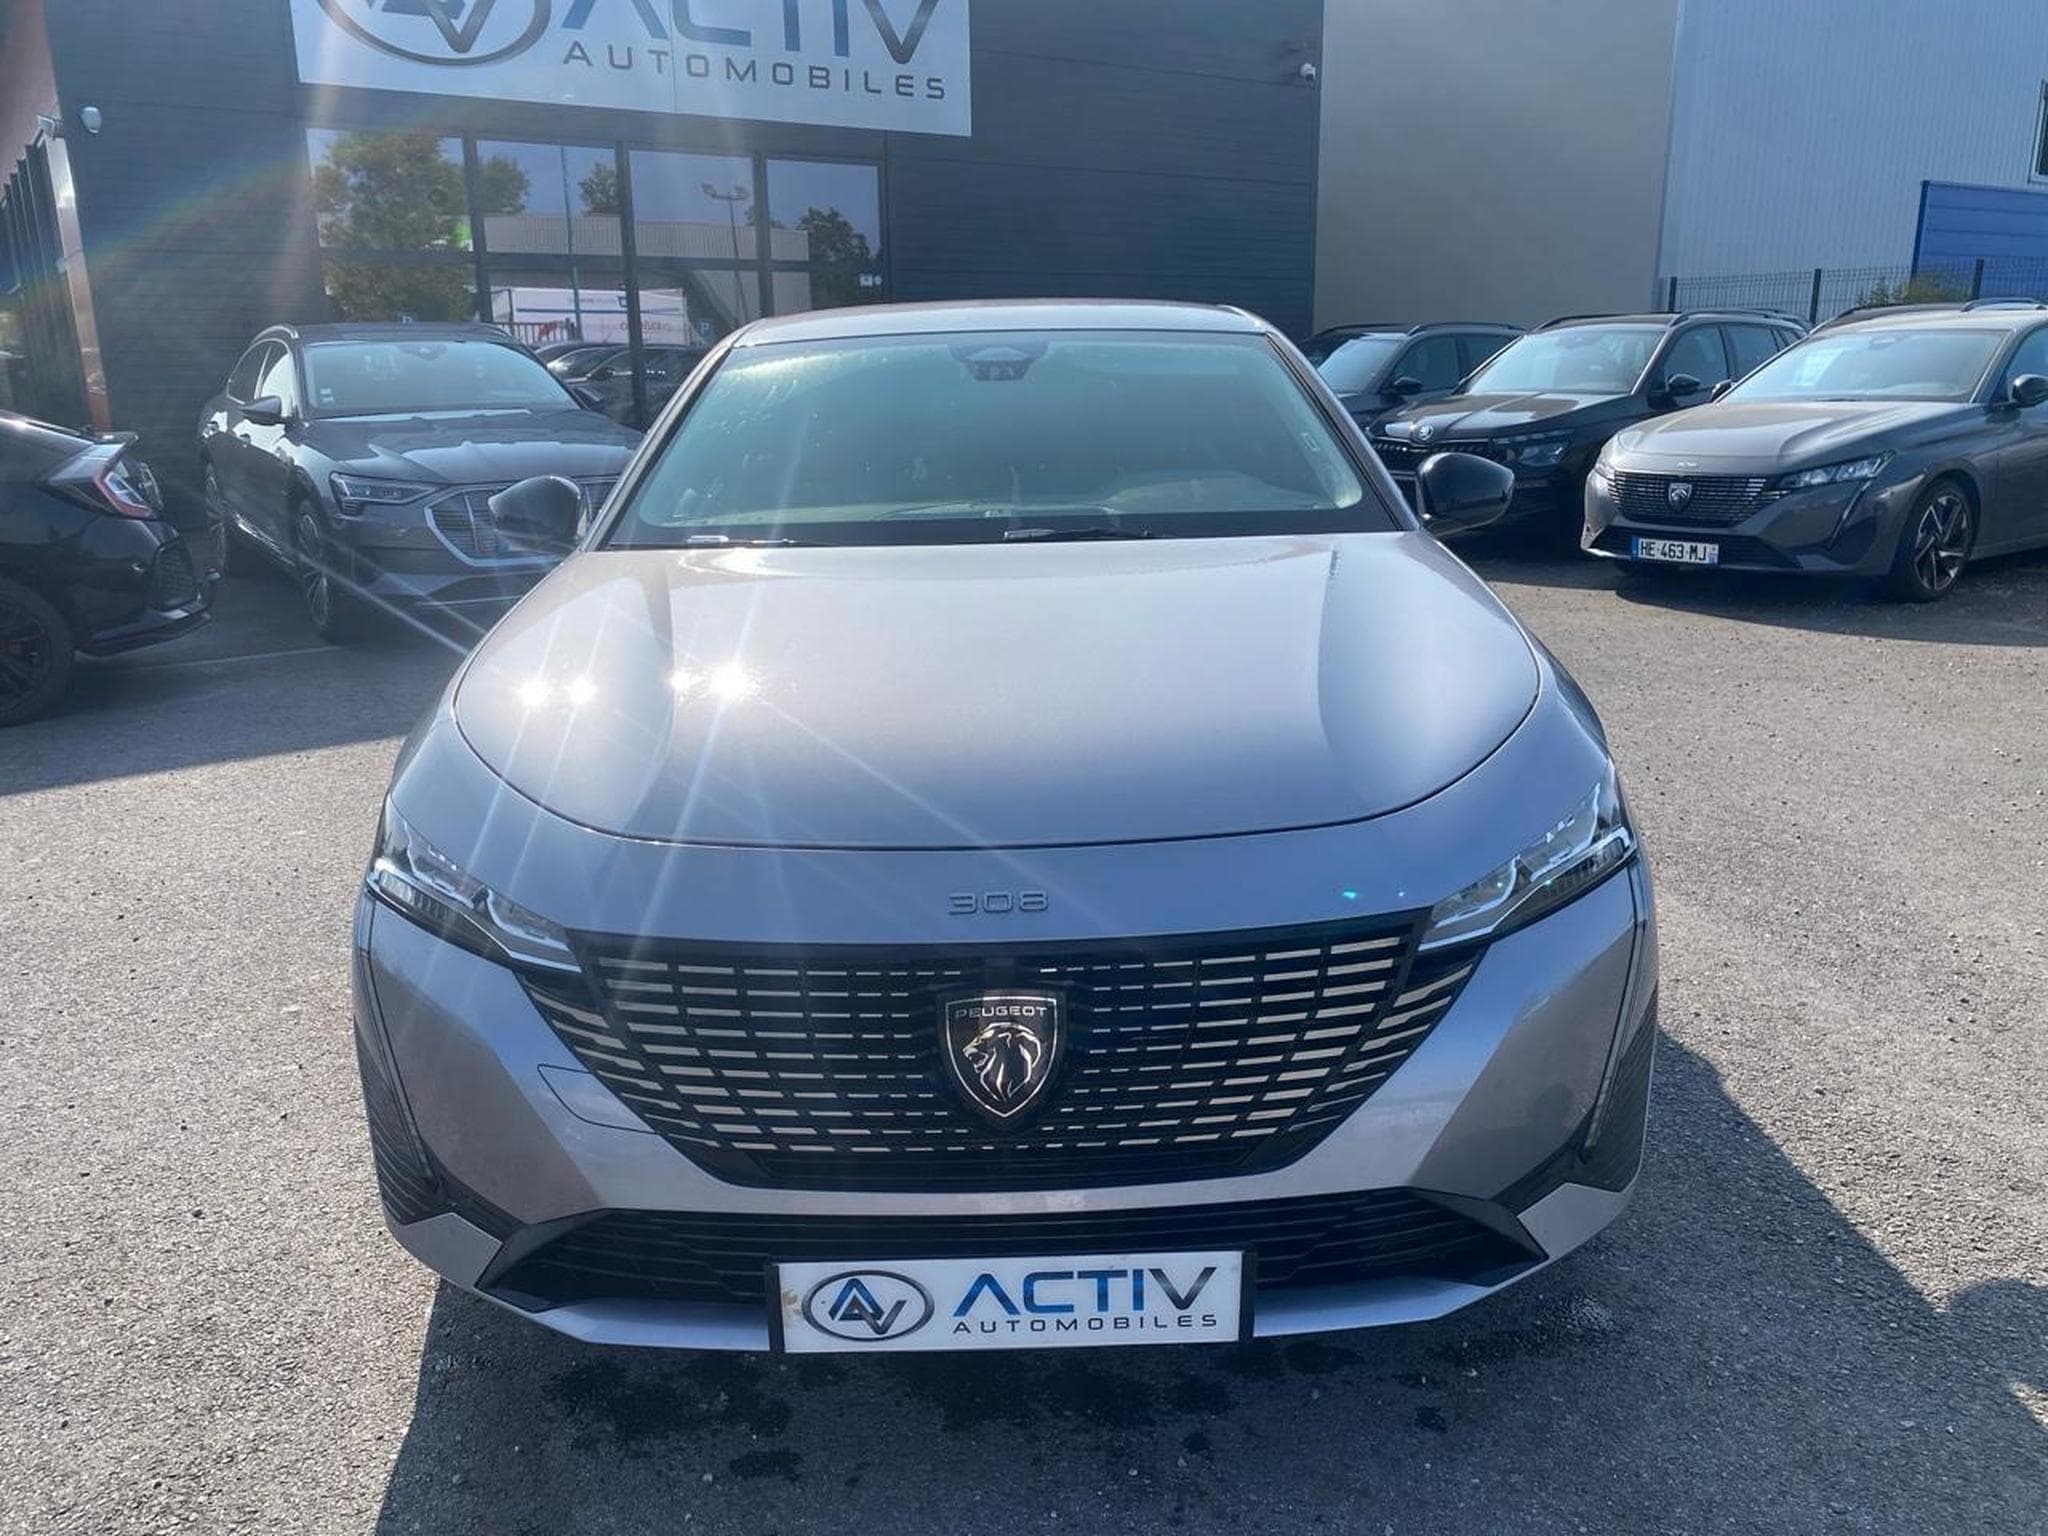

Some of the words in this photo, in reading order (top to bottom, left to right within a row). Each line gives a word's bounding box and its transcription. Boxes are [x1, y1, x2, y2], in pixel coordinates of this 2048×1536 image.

[562, 40, 946, 100] AUTOMOBILES
[949, 892, 1048, 915] 308
[955, 1006, 1048, 1018] PEUGEOT
[952, 1266, 1218, 1317] ACTIV
[952, 1313, 1218, 1334] AUTOMOBILES
